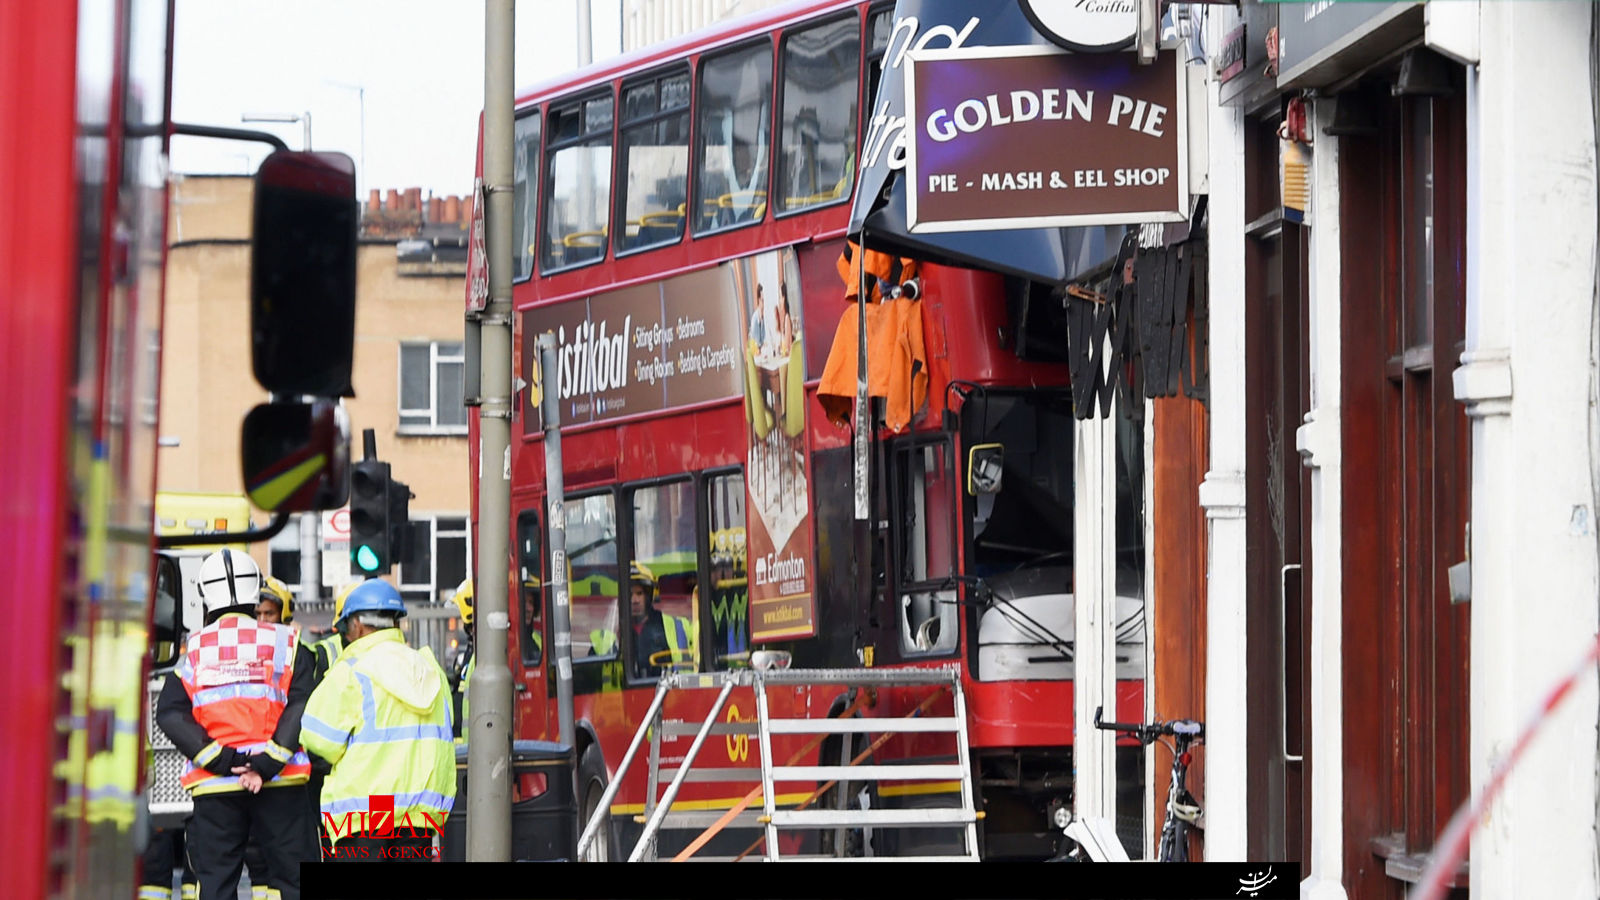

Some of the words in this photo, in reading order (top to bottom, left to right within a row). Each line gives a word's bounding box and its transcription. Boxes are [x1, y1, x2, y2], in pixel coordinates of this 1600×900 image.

[926, 88, 1094, 142] GOLDEN
[1107, 94, 1168, 138] PIE
[929, 174, 959, 192] PIE
[981, 171, 1043, 191] MASH
[1050, 170, 1067, 189] &
[1074, 170, 1108, 188] EEL
[1114, 167, 1170, 186] SHOP
[635, 326, 653, 352] Sitting
[653, 322, 674, 348] Groups
[678, 315, 705, 340] Bedrooms
[557, 314, 631, 399] istikbal
[637, 360, 655, 386] Dining
[654, 356, 674, 378] Rooms
[680, 349, 702, 376] Bedding
[706, 343, 735, 370] Carpeting
[768, 550, 805, 583] Edmonton
